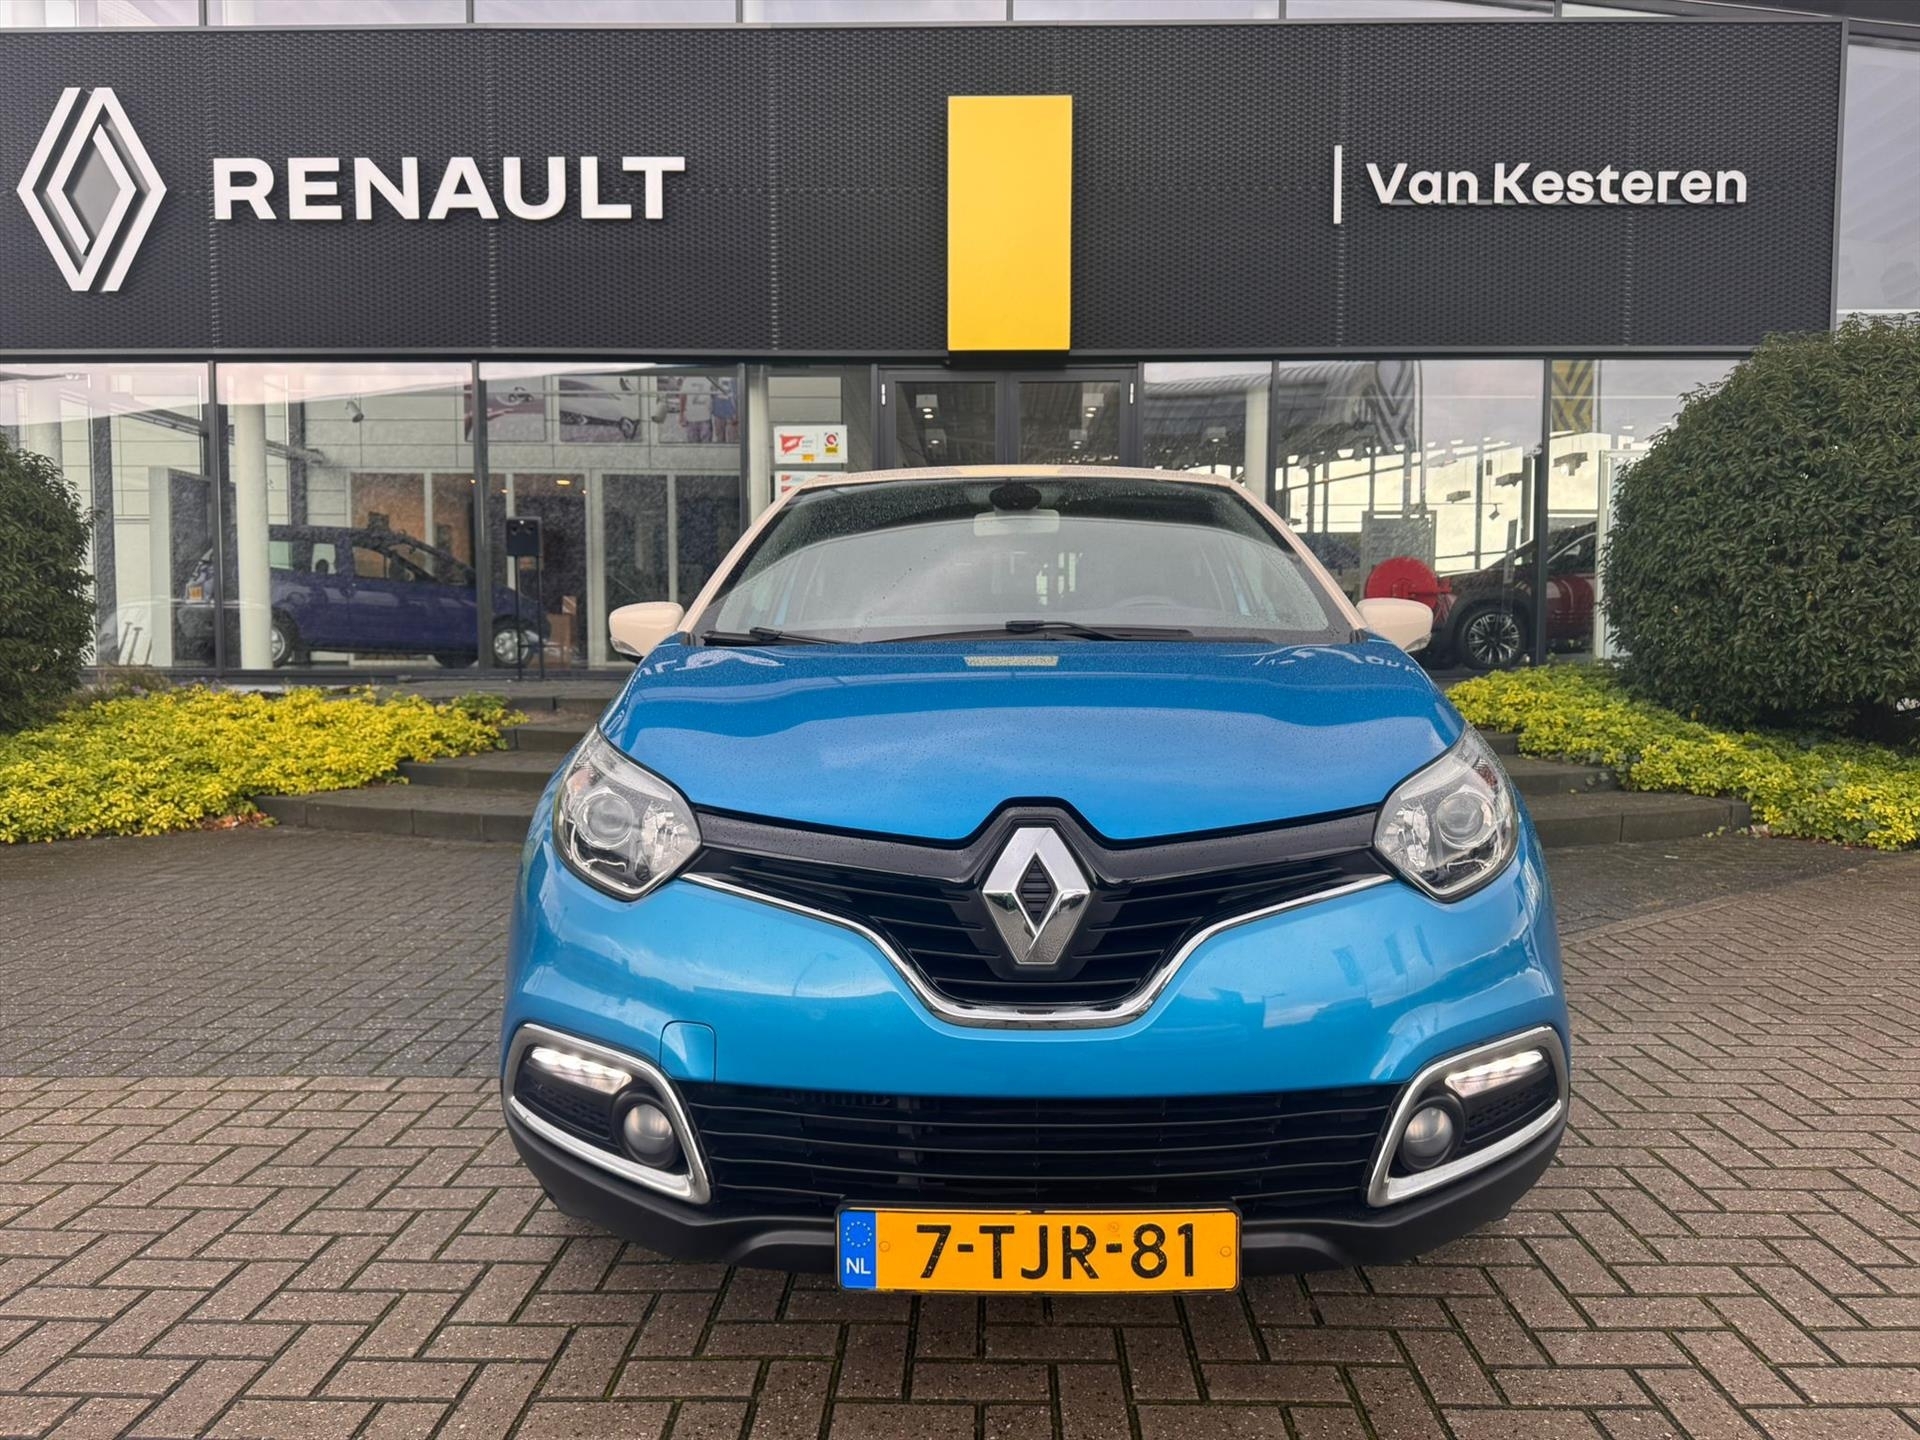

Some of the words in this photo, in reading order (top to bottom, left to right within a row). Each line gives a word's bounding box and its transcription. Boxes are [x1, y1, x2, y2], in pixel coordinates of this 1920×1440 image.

[212, 155, 686, 221] RENAULT
[1365, 162, 1479, 205] Van
[1493, 162, 1748, 205] Kesteren
[845, 1256, 872, 1276] NL
[915, 1222, 1195, 1281] 7-TJR-81
